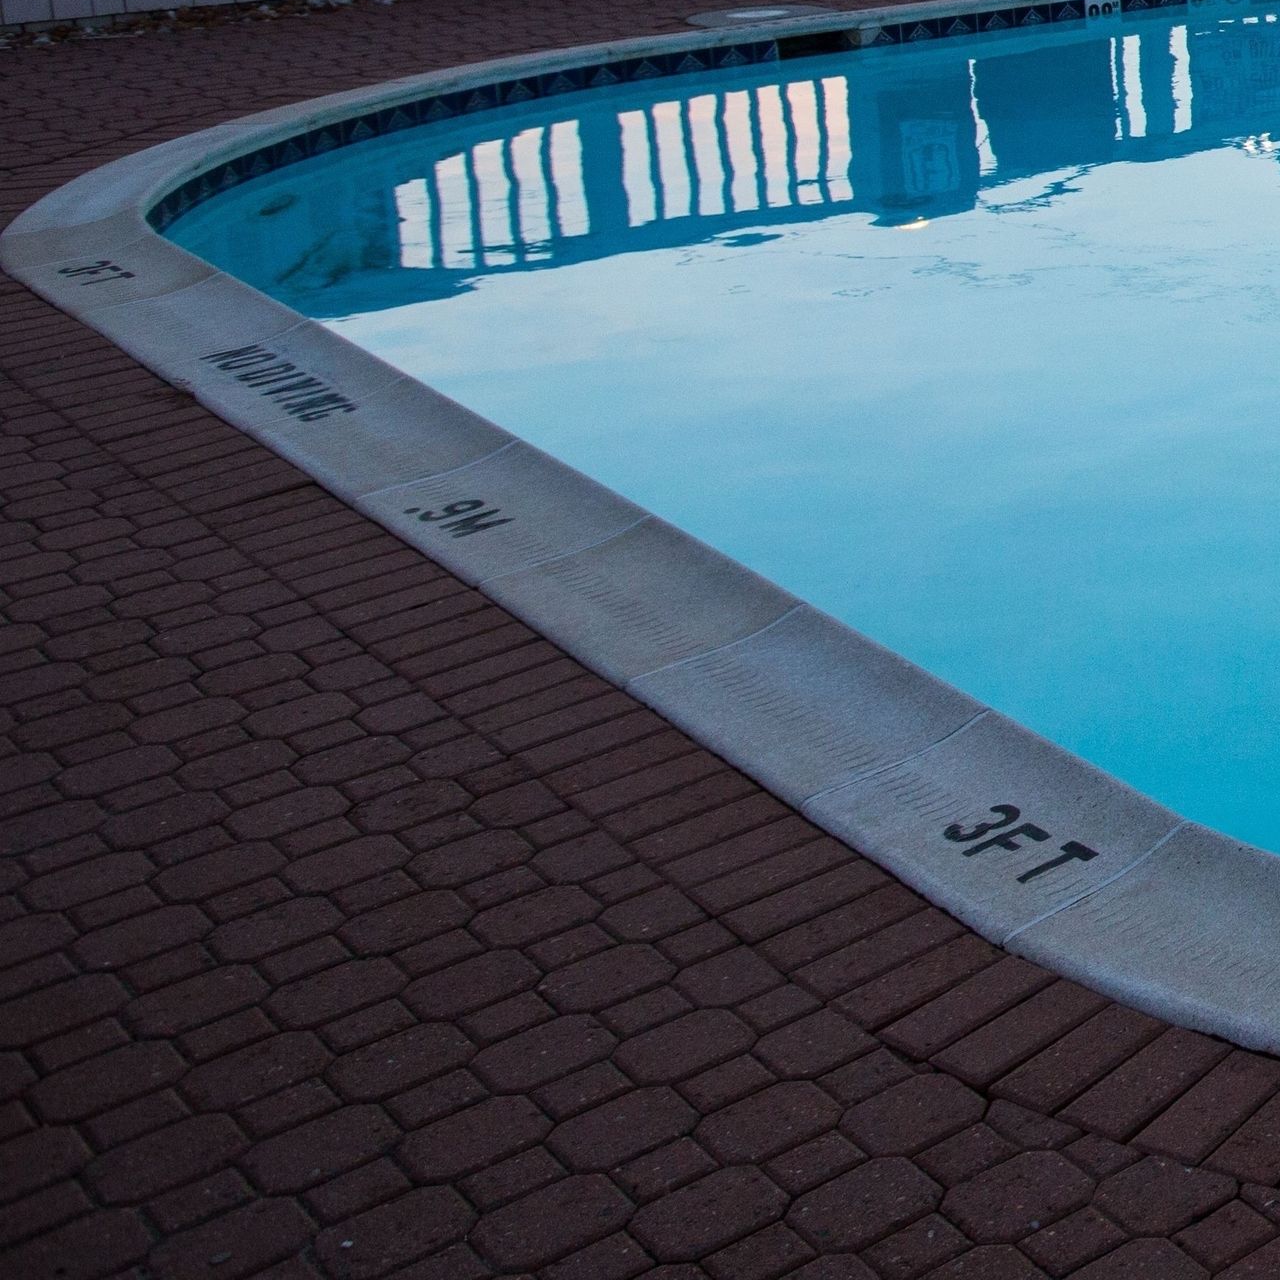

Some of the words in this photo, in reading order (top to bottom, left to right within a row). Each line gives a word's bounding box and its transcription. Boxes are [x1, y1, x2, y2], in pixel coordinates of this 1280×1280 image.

[199, 344, 278, 370] NO
[235, 362, 360, 422] DIVING
[943, 803, 1099, 884] 3FT
